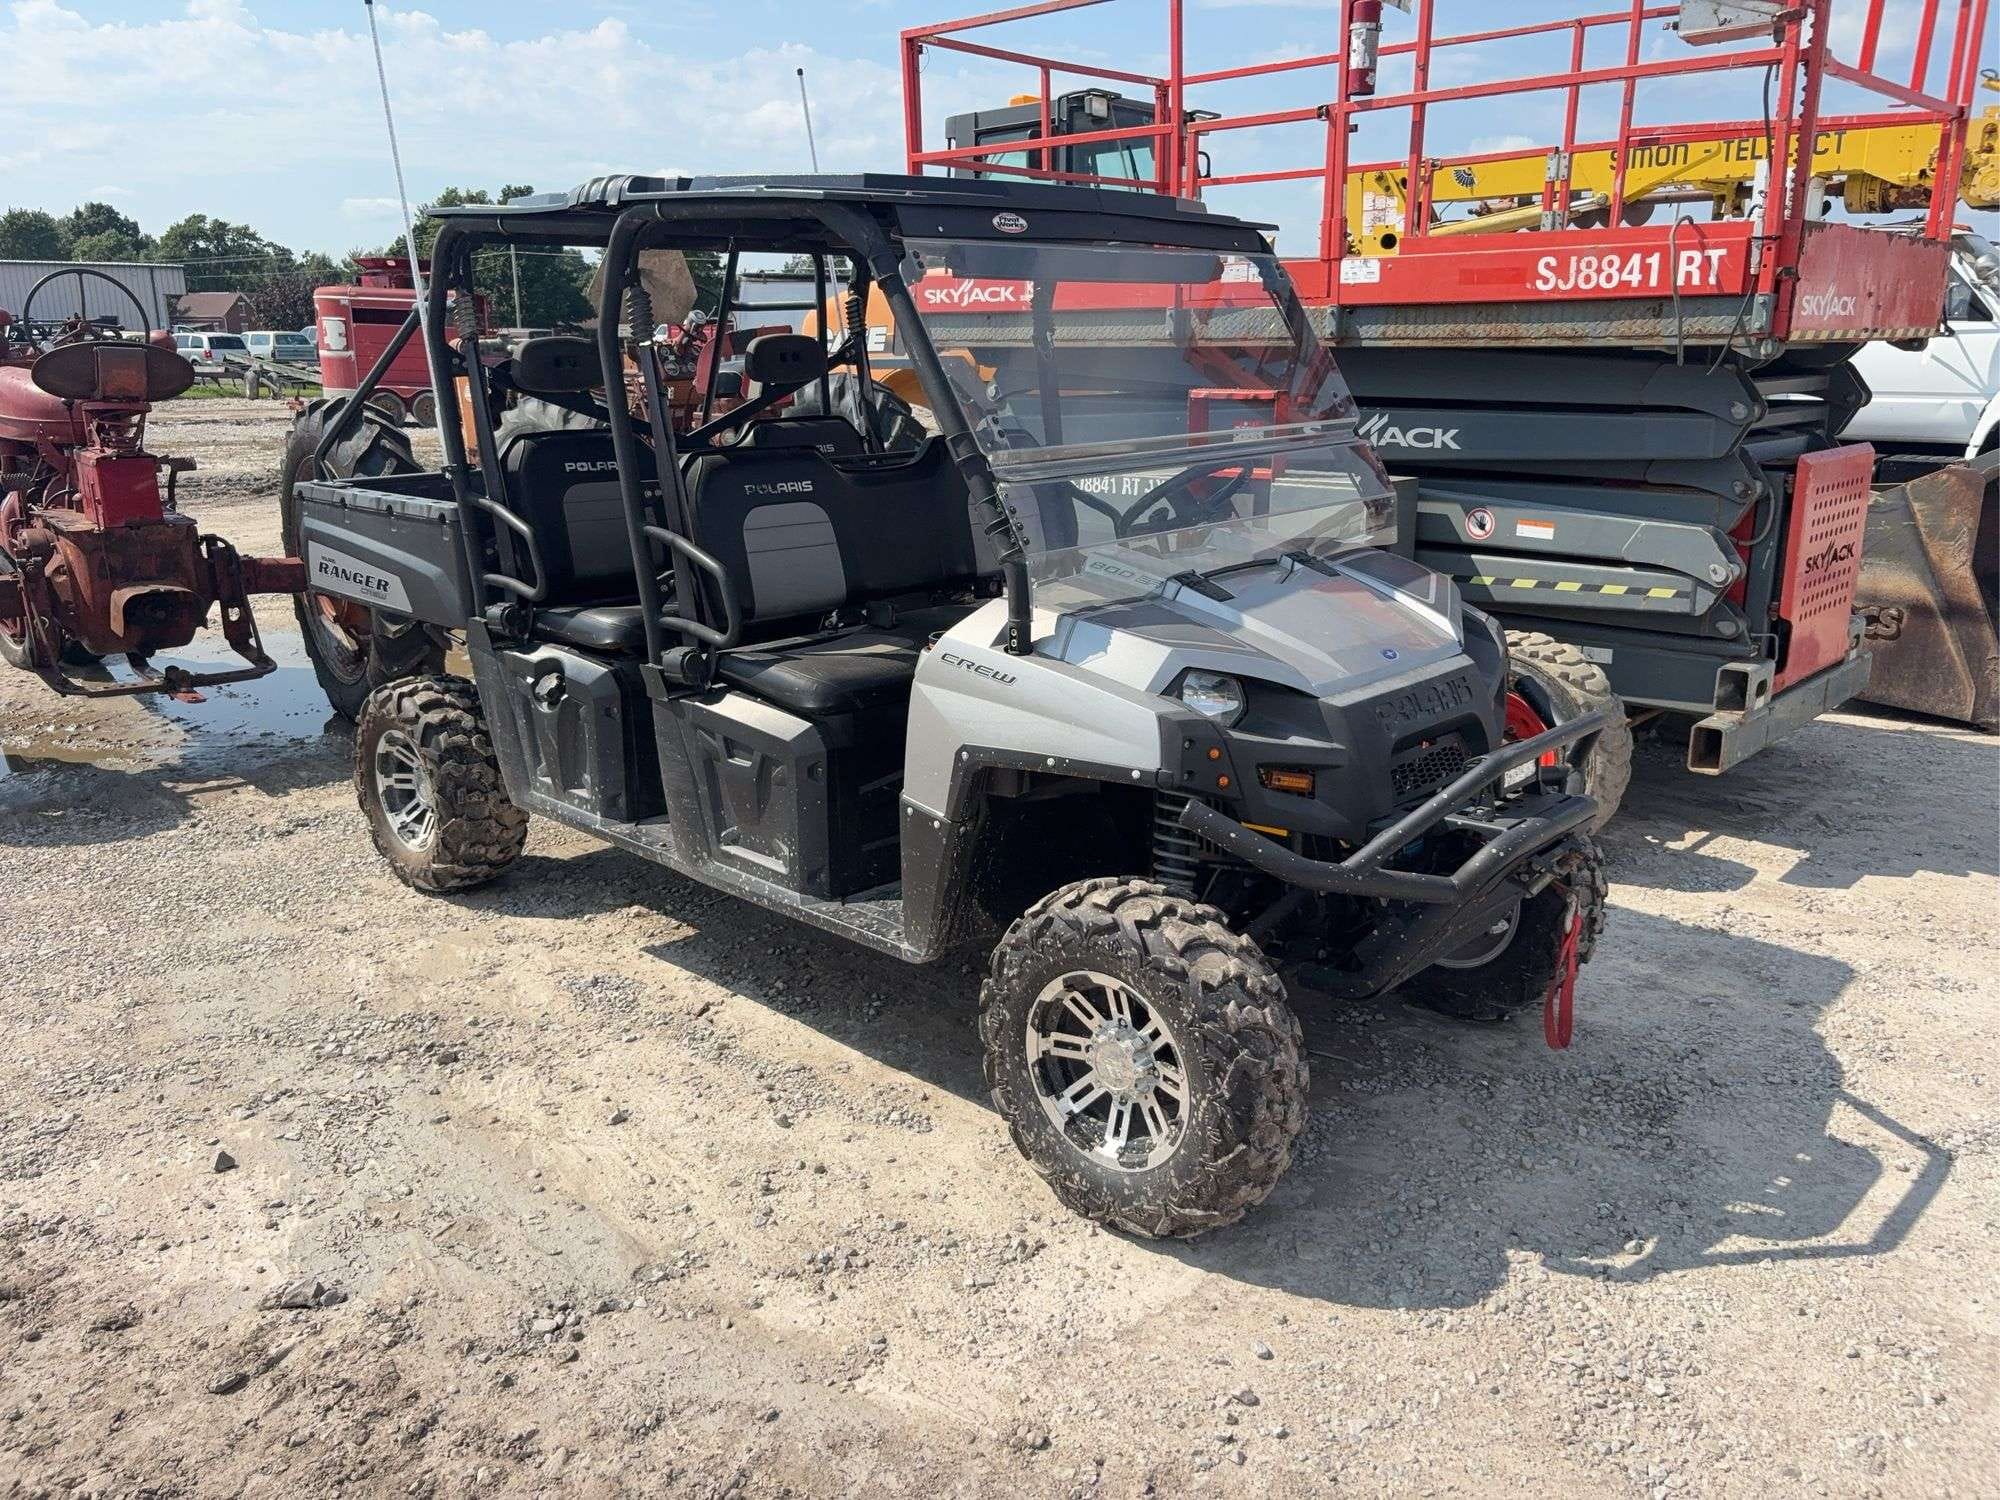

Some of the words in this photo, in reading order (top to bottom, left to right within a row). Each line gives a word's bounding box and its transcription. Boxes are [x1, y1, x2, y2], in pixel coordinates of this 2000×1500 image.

[1722, 130, 1847, 163] TELCT
[1535, 252, 1661, 291] SJ8841
[1676, 248, 1728, 287] RT
[924, 279, 1016, 307] SKYJACK
[1800, 281, 1857, 320] SKYJACK
[564, 461, 620, 473] POLAR
[744, 481, 813, 495] POLARIS
[1121, 477, 1141, 496] RT
[1805, 540, 1856, 574] SKYJACK
[318, 561, 390, 593] RANGER
[941, 653, 1017, 684] CREW
[1377, 676, 1473, 732] POLARIS
